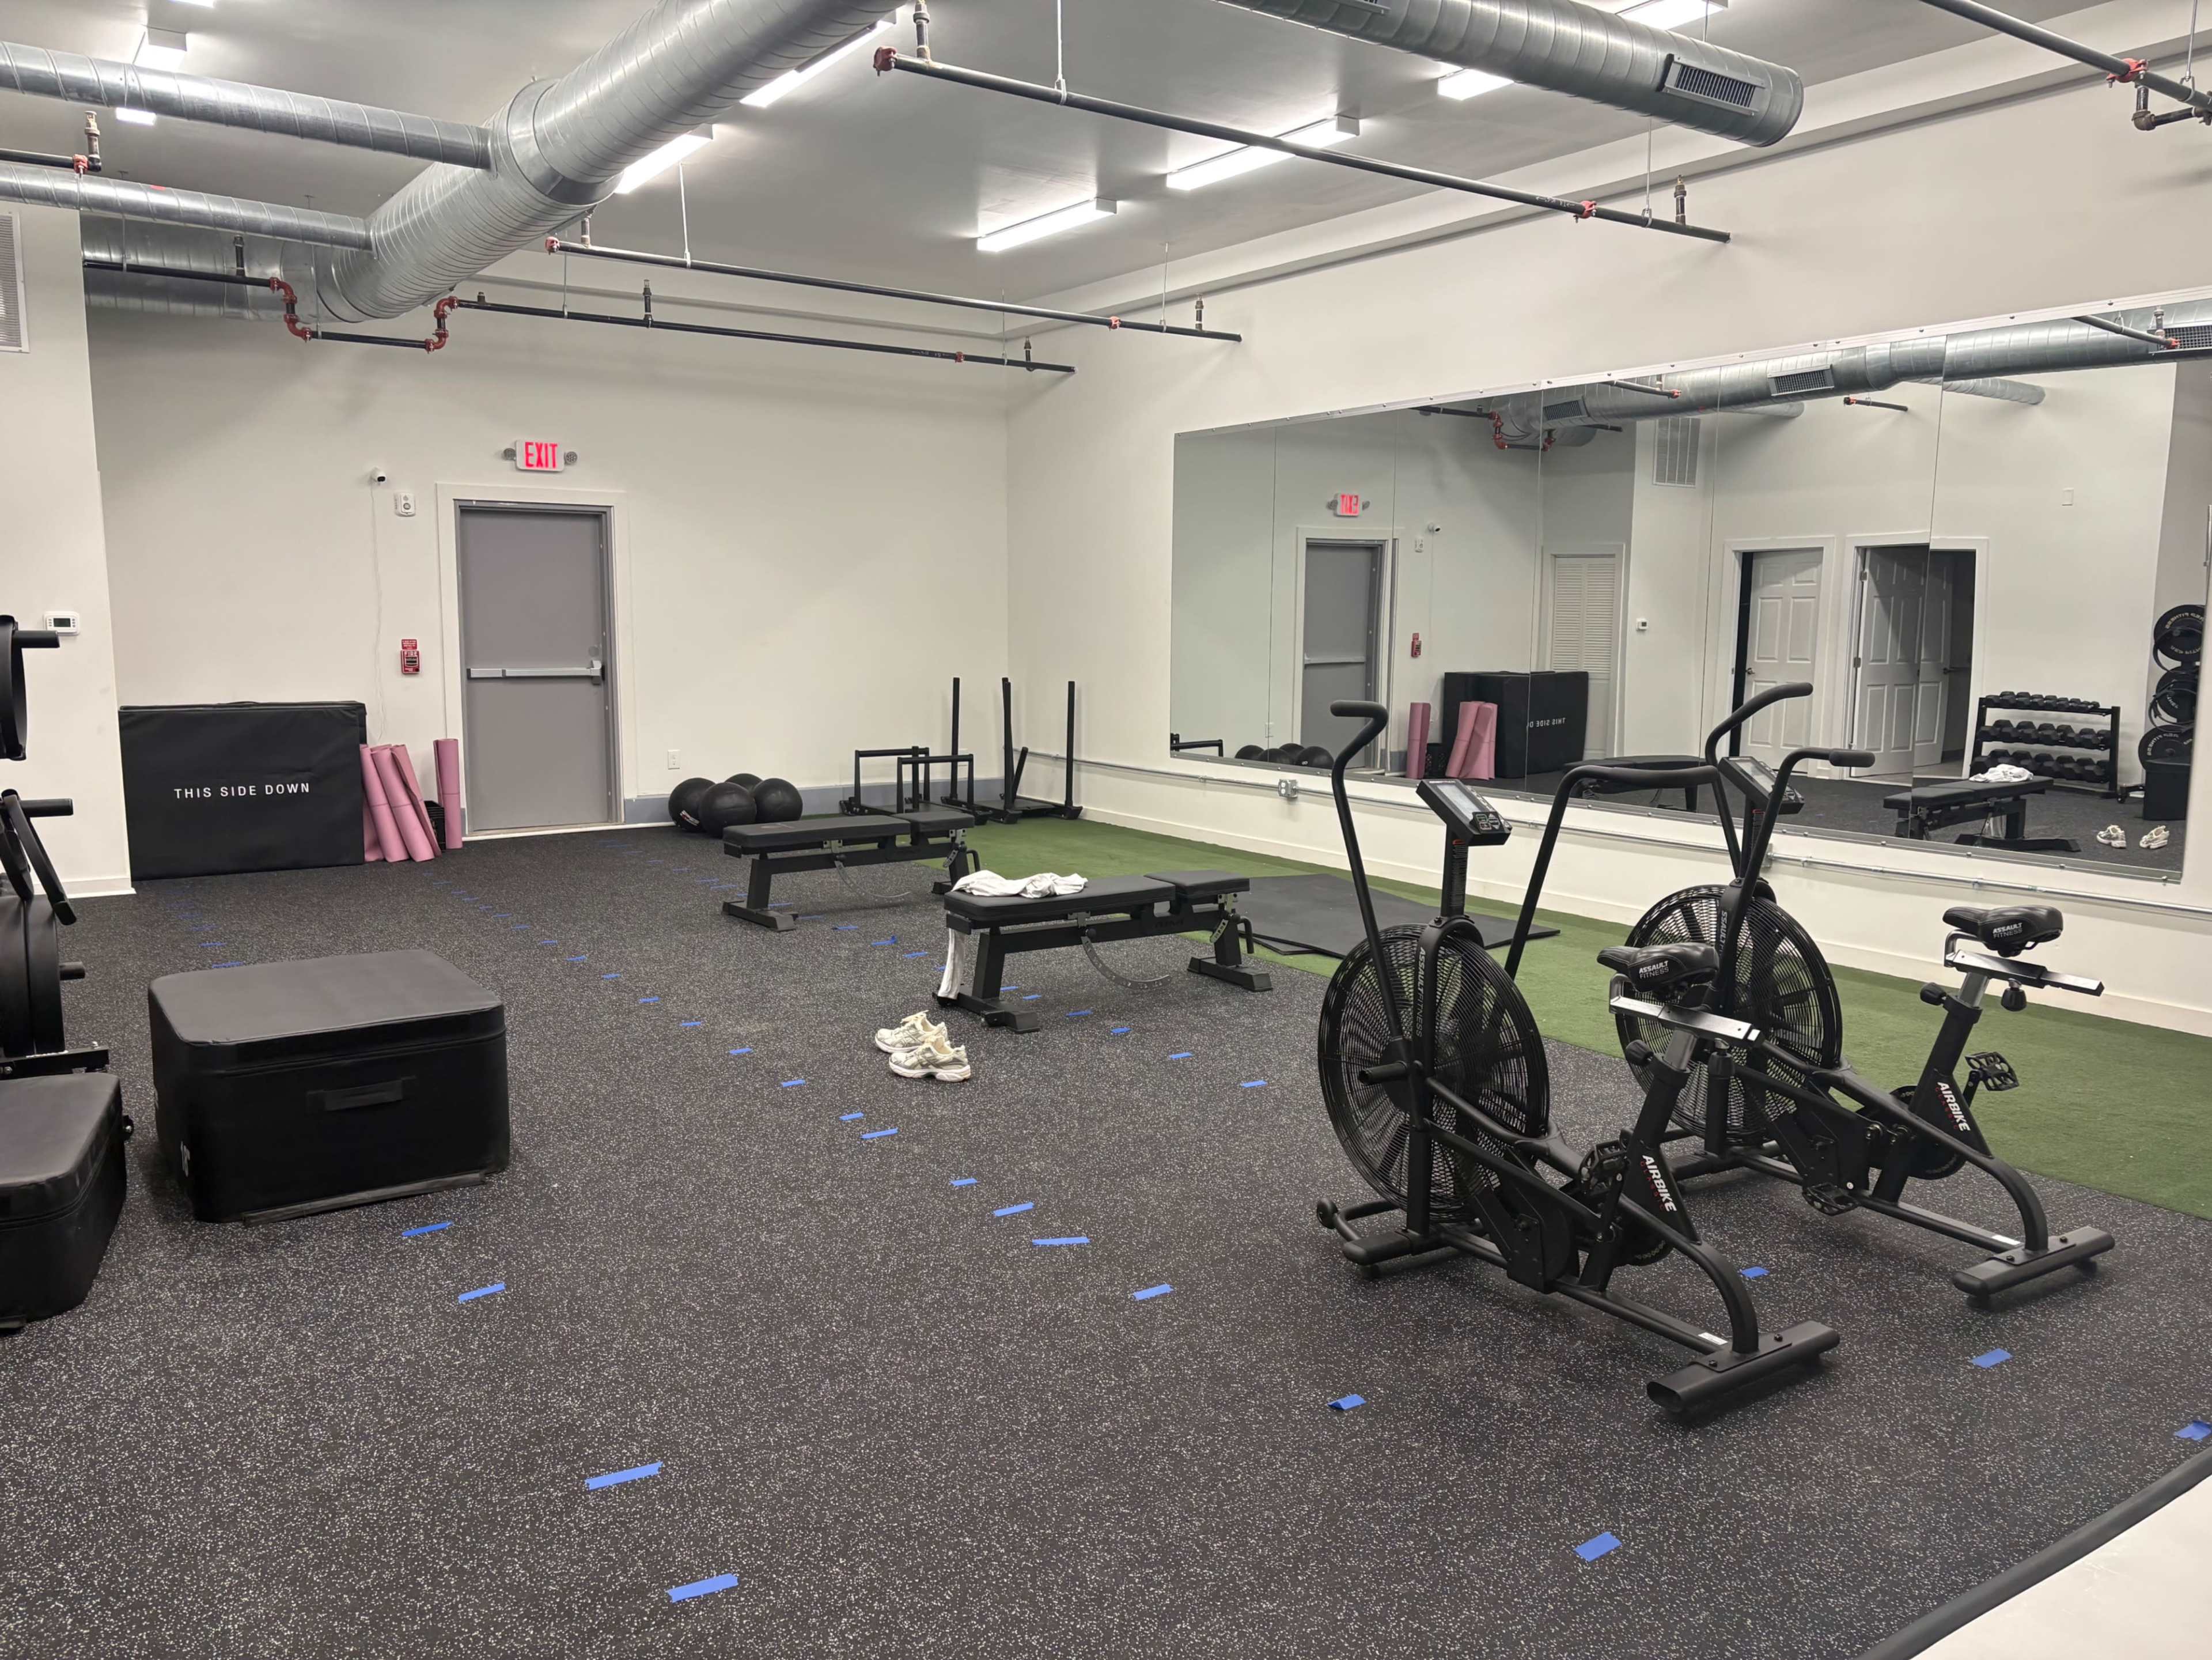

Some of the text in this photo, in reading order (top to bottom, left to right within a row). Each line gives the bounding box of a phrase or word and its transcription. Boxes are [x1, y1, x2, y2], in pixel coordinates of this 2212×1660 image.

[525, 441, 558, 468] EXIT
[174, 782, 309, 799] THIS SIDE DOWN
[1993, 922, 2022, 933] ASSAULT
[1994, 928, 2023, 939] FITNESS
[1639, 961, 1668, 974] ASSAULT
[1639, 966, 1669, 980] FITNESS
[1415, 946, 1426, 1037] ASSAULT FITNESS
[1937, 1082, 1971, 1132] AIRBIKE
[1642, 1155, 1677, 1212] AIRBIKE
